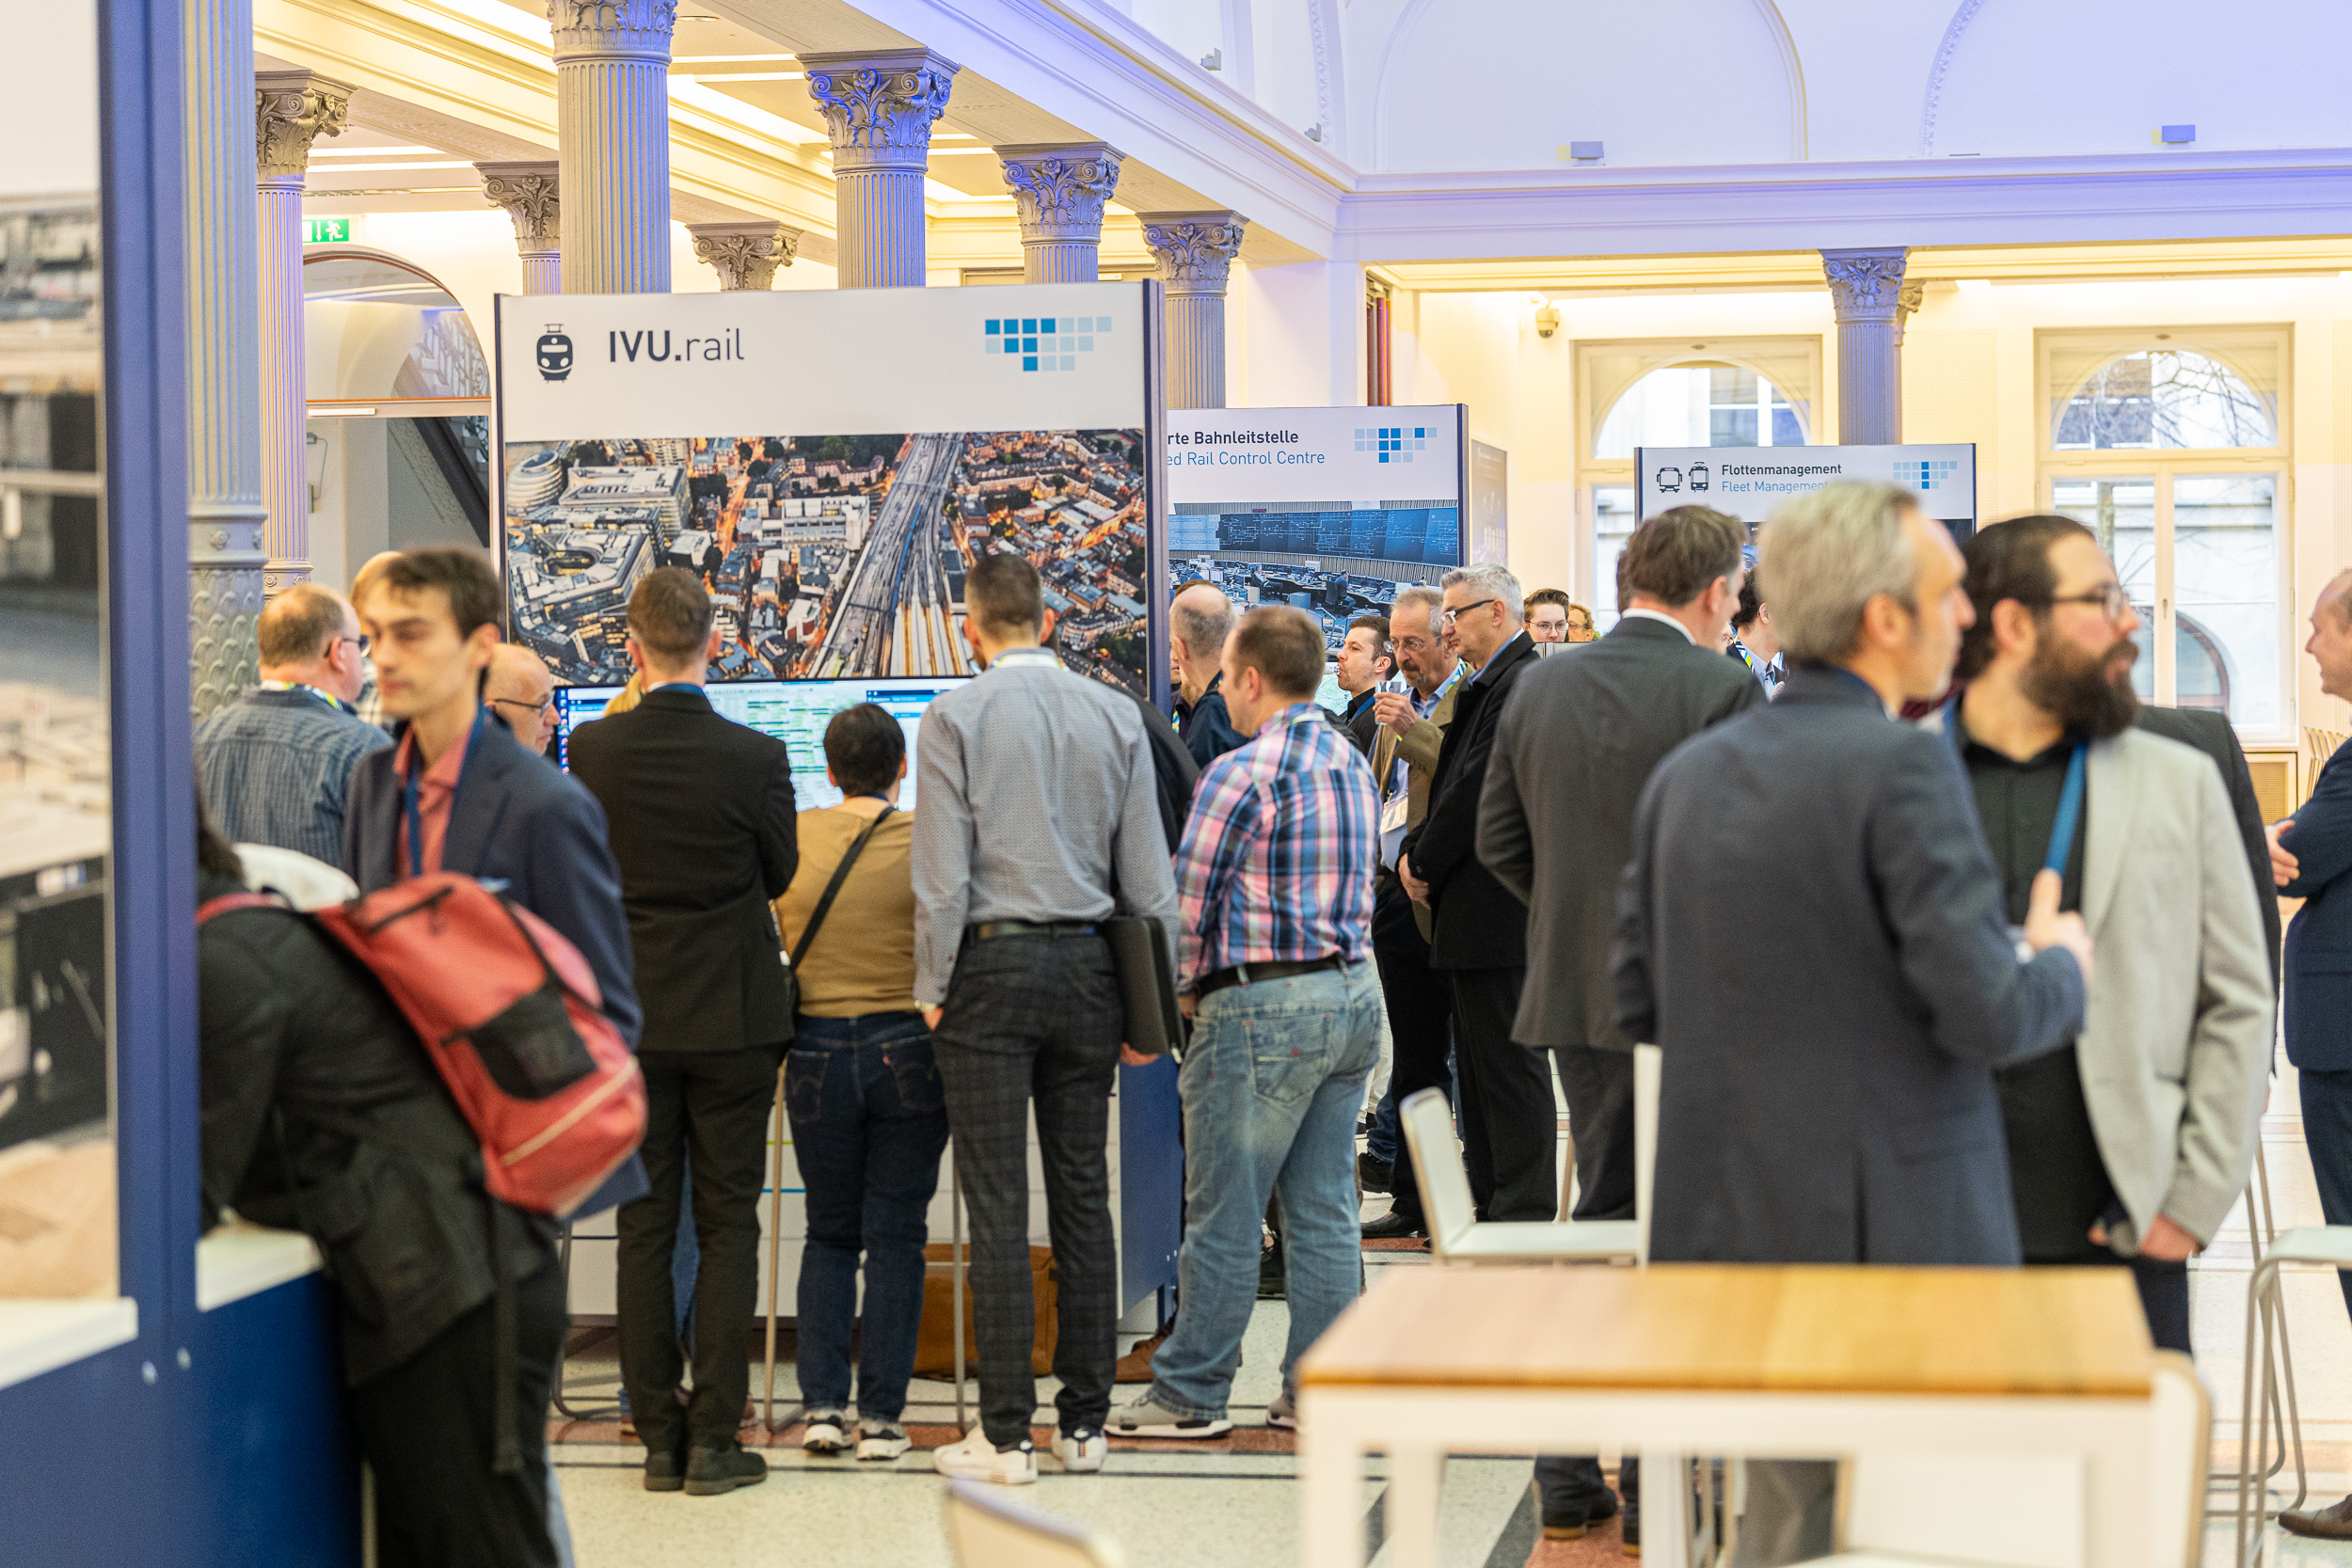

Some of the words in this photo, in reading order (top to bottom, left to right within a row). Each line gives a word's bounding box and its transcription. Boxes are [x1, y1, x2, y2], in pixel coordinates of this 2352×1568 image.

[610, 328, 744, 362] IVU.rail
[1194, 430, 1299, 445] Bahnleitstelle
[1187, 451, 1214, 466] Rail
[1219, 451, 1272, 466] Control
[1277, 451, 1325, 465] Centre
[1722, 464, 1842, 477] Flottenmanagement
[1722, 481, 1751, 492] Fleet
